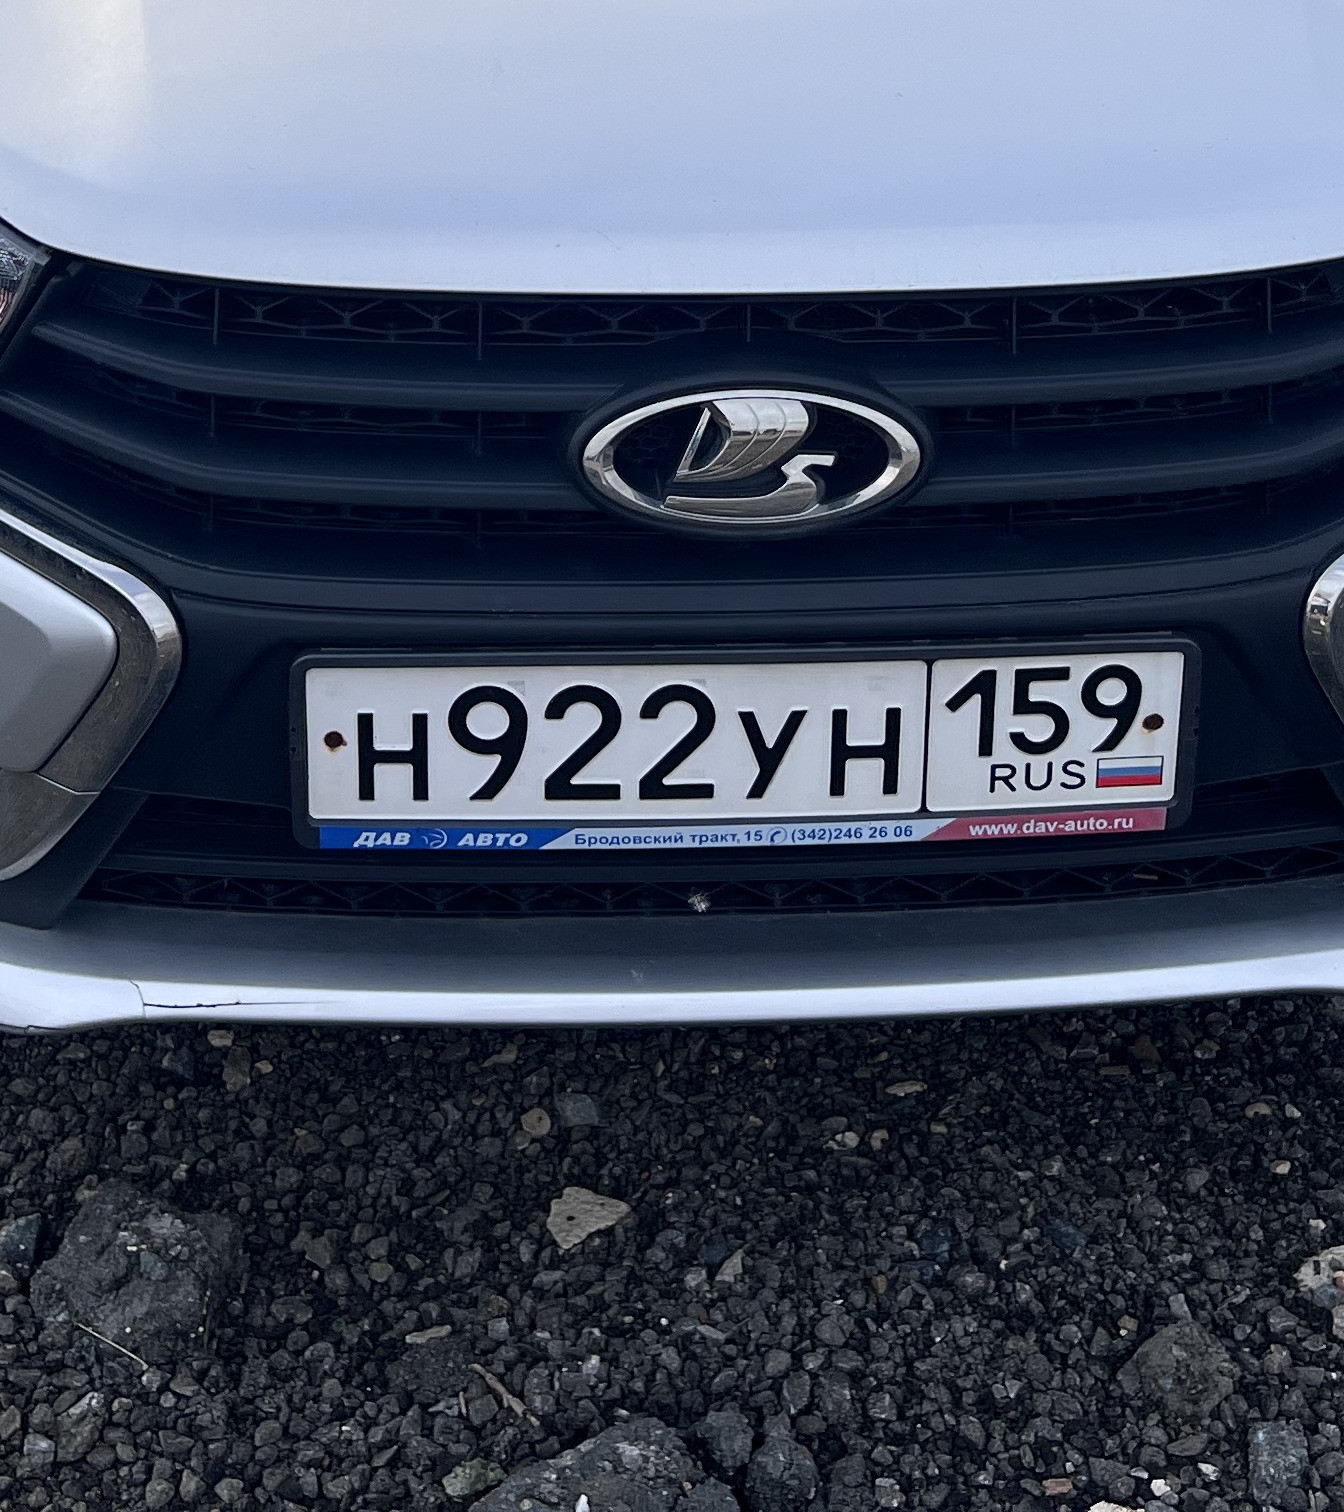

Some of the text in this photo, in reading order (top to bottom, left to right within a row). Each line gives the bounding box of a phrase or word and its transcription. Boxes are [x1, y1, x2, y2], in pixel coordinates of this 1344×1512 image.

[944, 663, 1144, 757] 159
[989, 759, 1087, 793] RUS
[790, 824, 914, 845] (342)246 26 06
[968, 815, 1135, 837] www.dav-auto.ru
[352, 830, 529, 848] ДАВ АВТО
[574, 830, 764, 848] Бродовский тракт, 15
